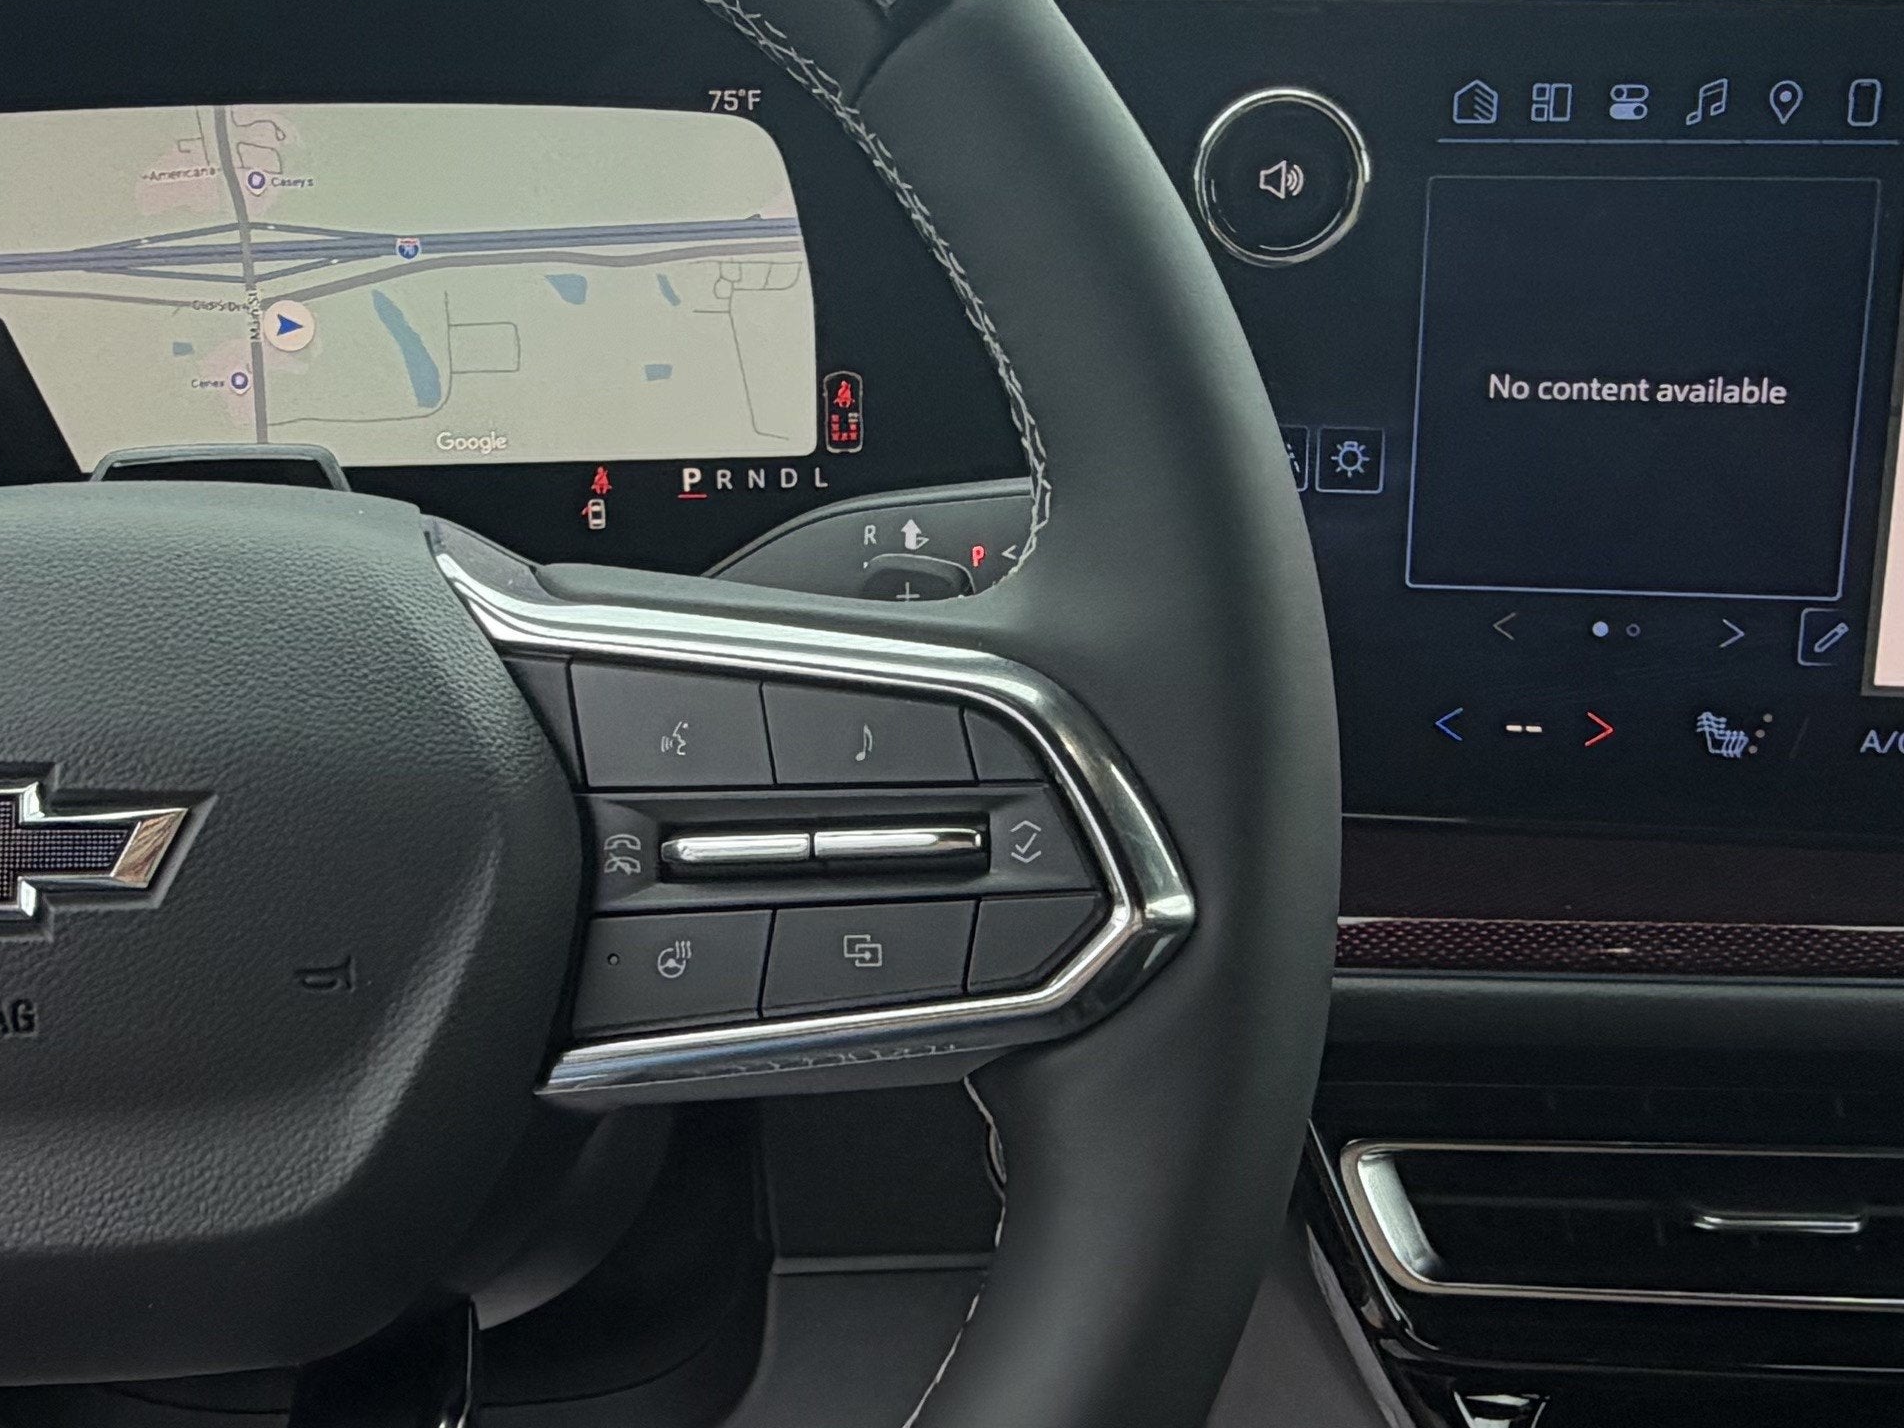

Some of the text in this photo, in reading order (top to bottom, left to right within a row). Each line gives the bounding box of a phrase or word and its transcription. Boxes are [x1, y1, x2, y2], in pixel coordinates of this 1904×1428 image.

[707, 89, 762, 112] 75°F
[1488, 374, 1787, 405] No content available
[436, 431, 507, 454] Google
[682, 468, 829, 490] P R N D L
[863, 524, 878, 545] R
[972, 545, 985, 567] P
